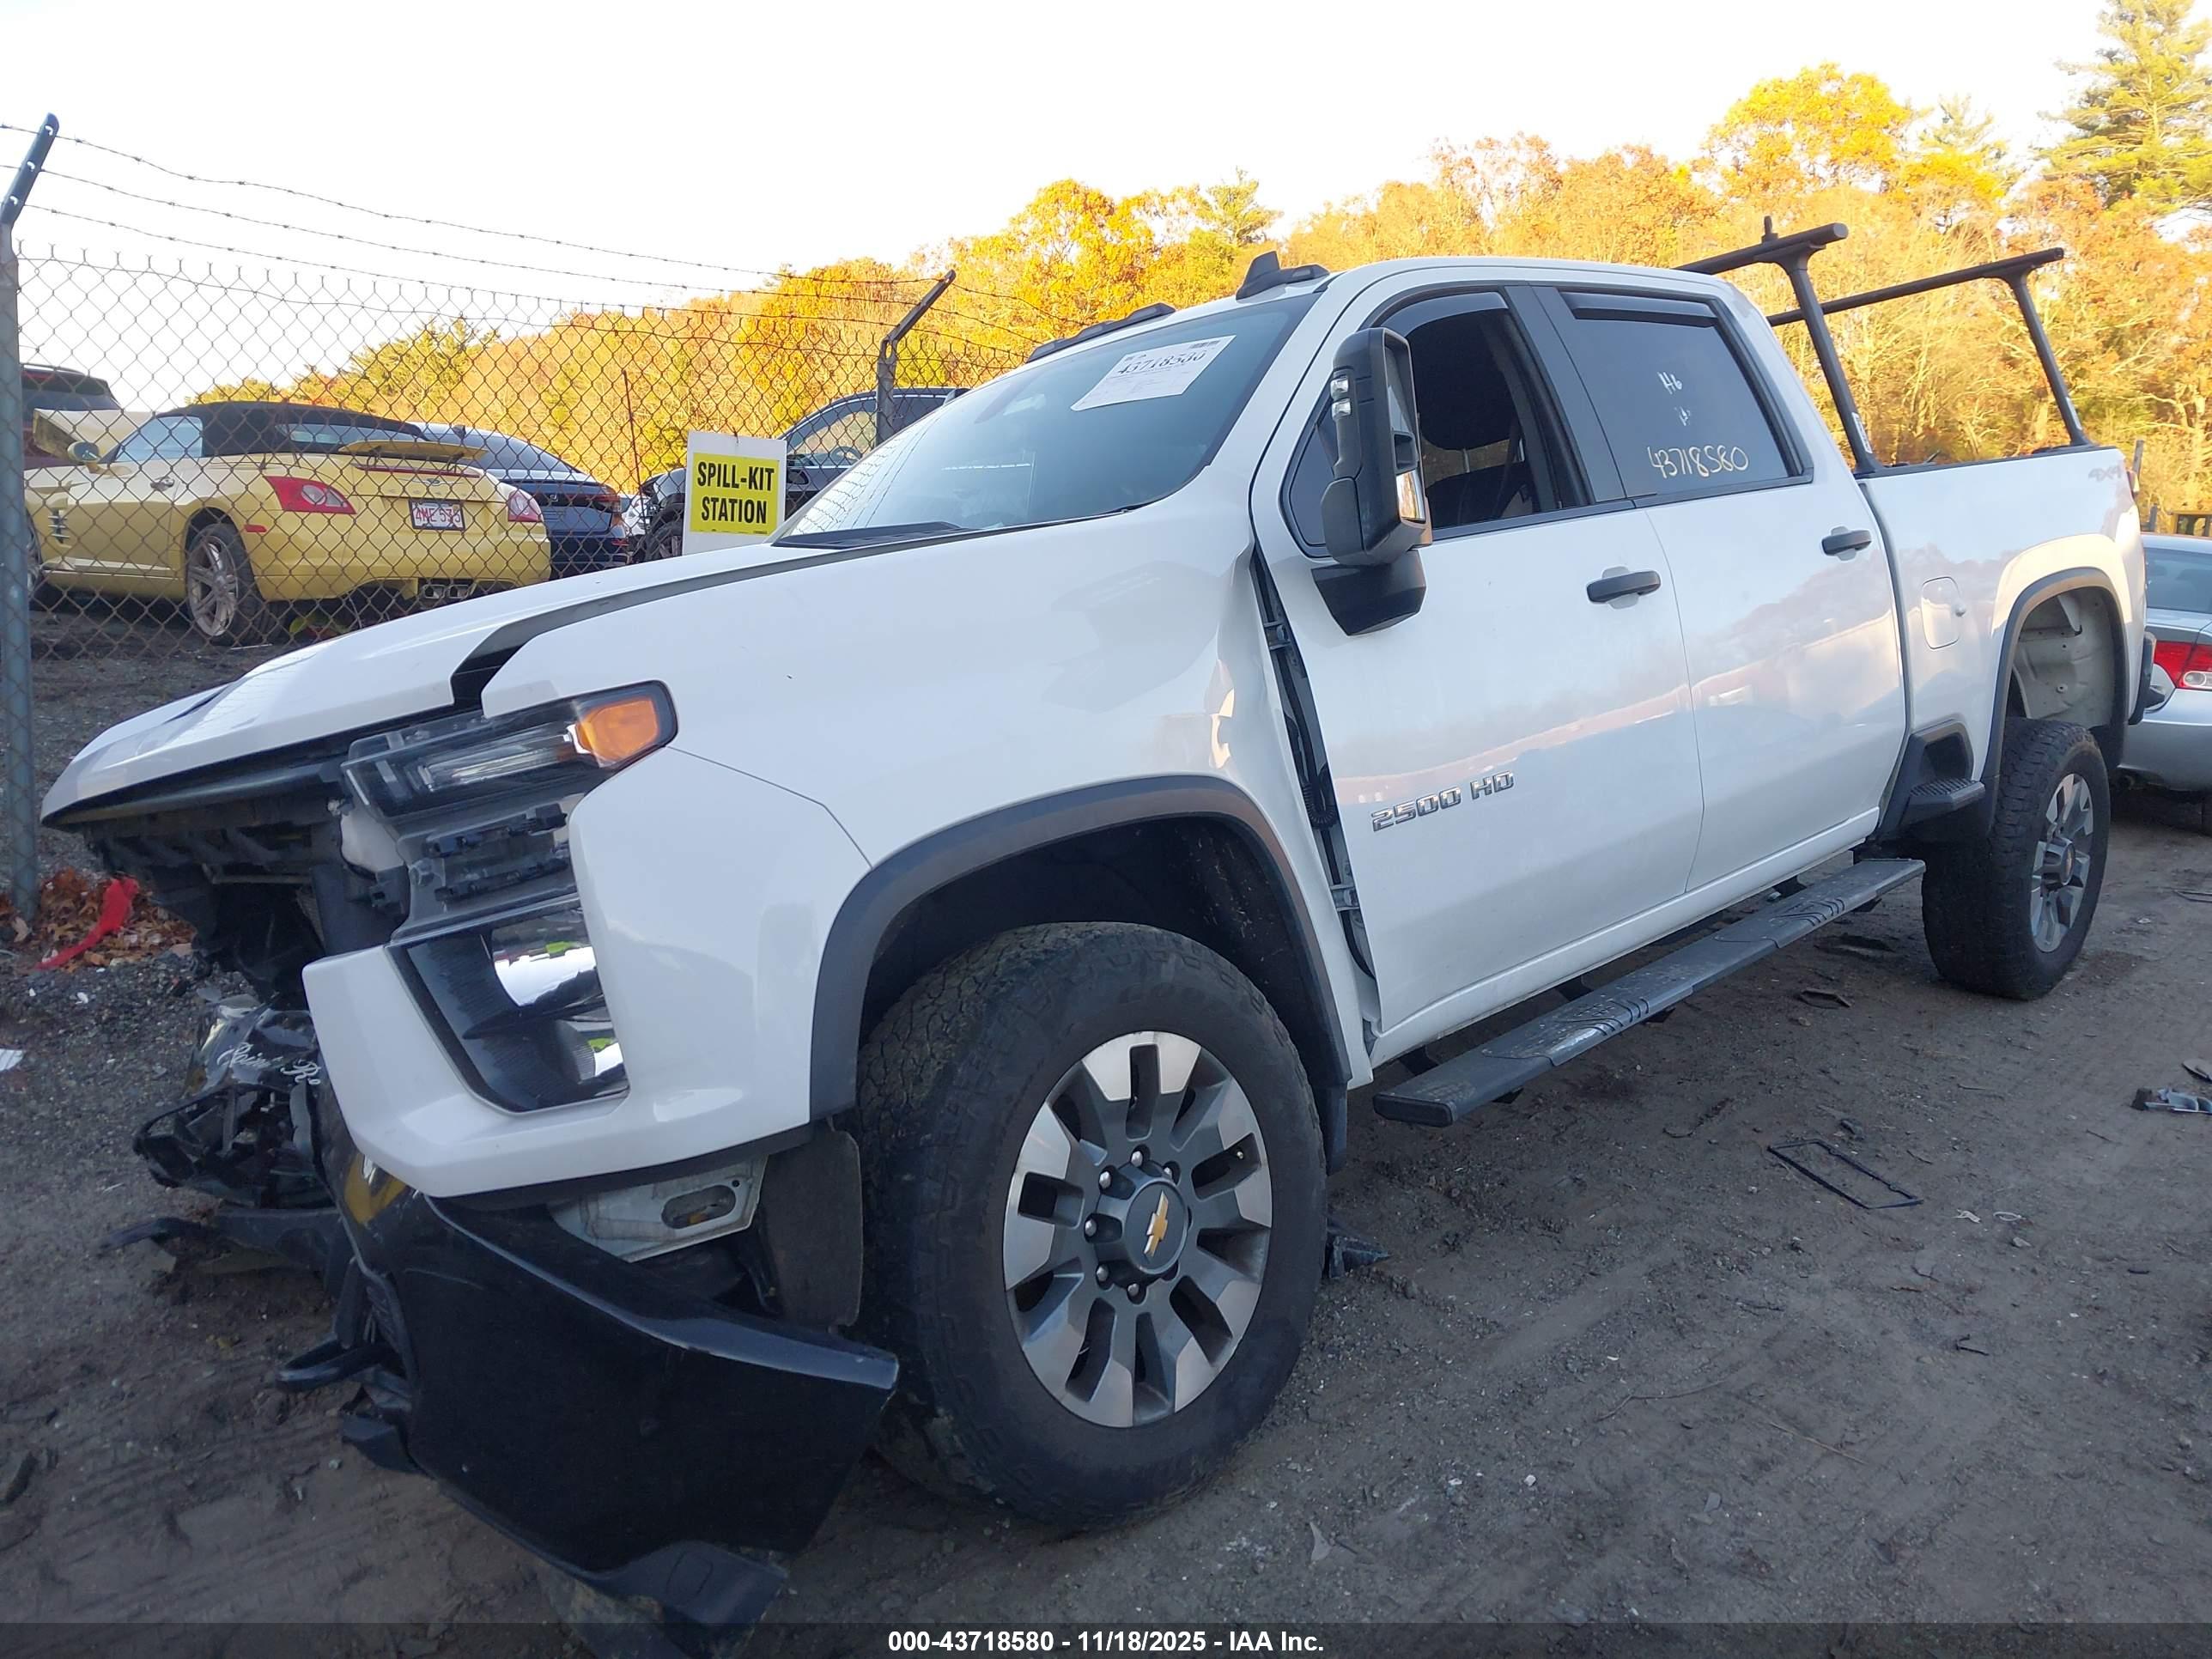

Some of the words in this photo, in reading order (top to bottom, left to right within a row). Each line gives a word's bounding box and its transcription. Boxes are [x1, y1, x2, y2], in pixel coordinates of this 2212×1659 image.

[697, 461, 775, 492] SPILL-KIT
[1647, 445, 1749, 479] 43718580
[701, 495, 768, 525] STATION
[1370, 785, 1462, 833] 2500
[1469, 769, 1515, 800] HD
